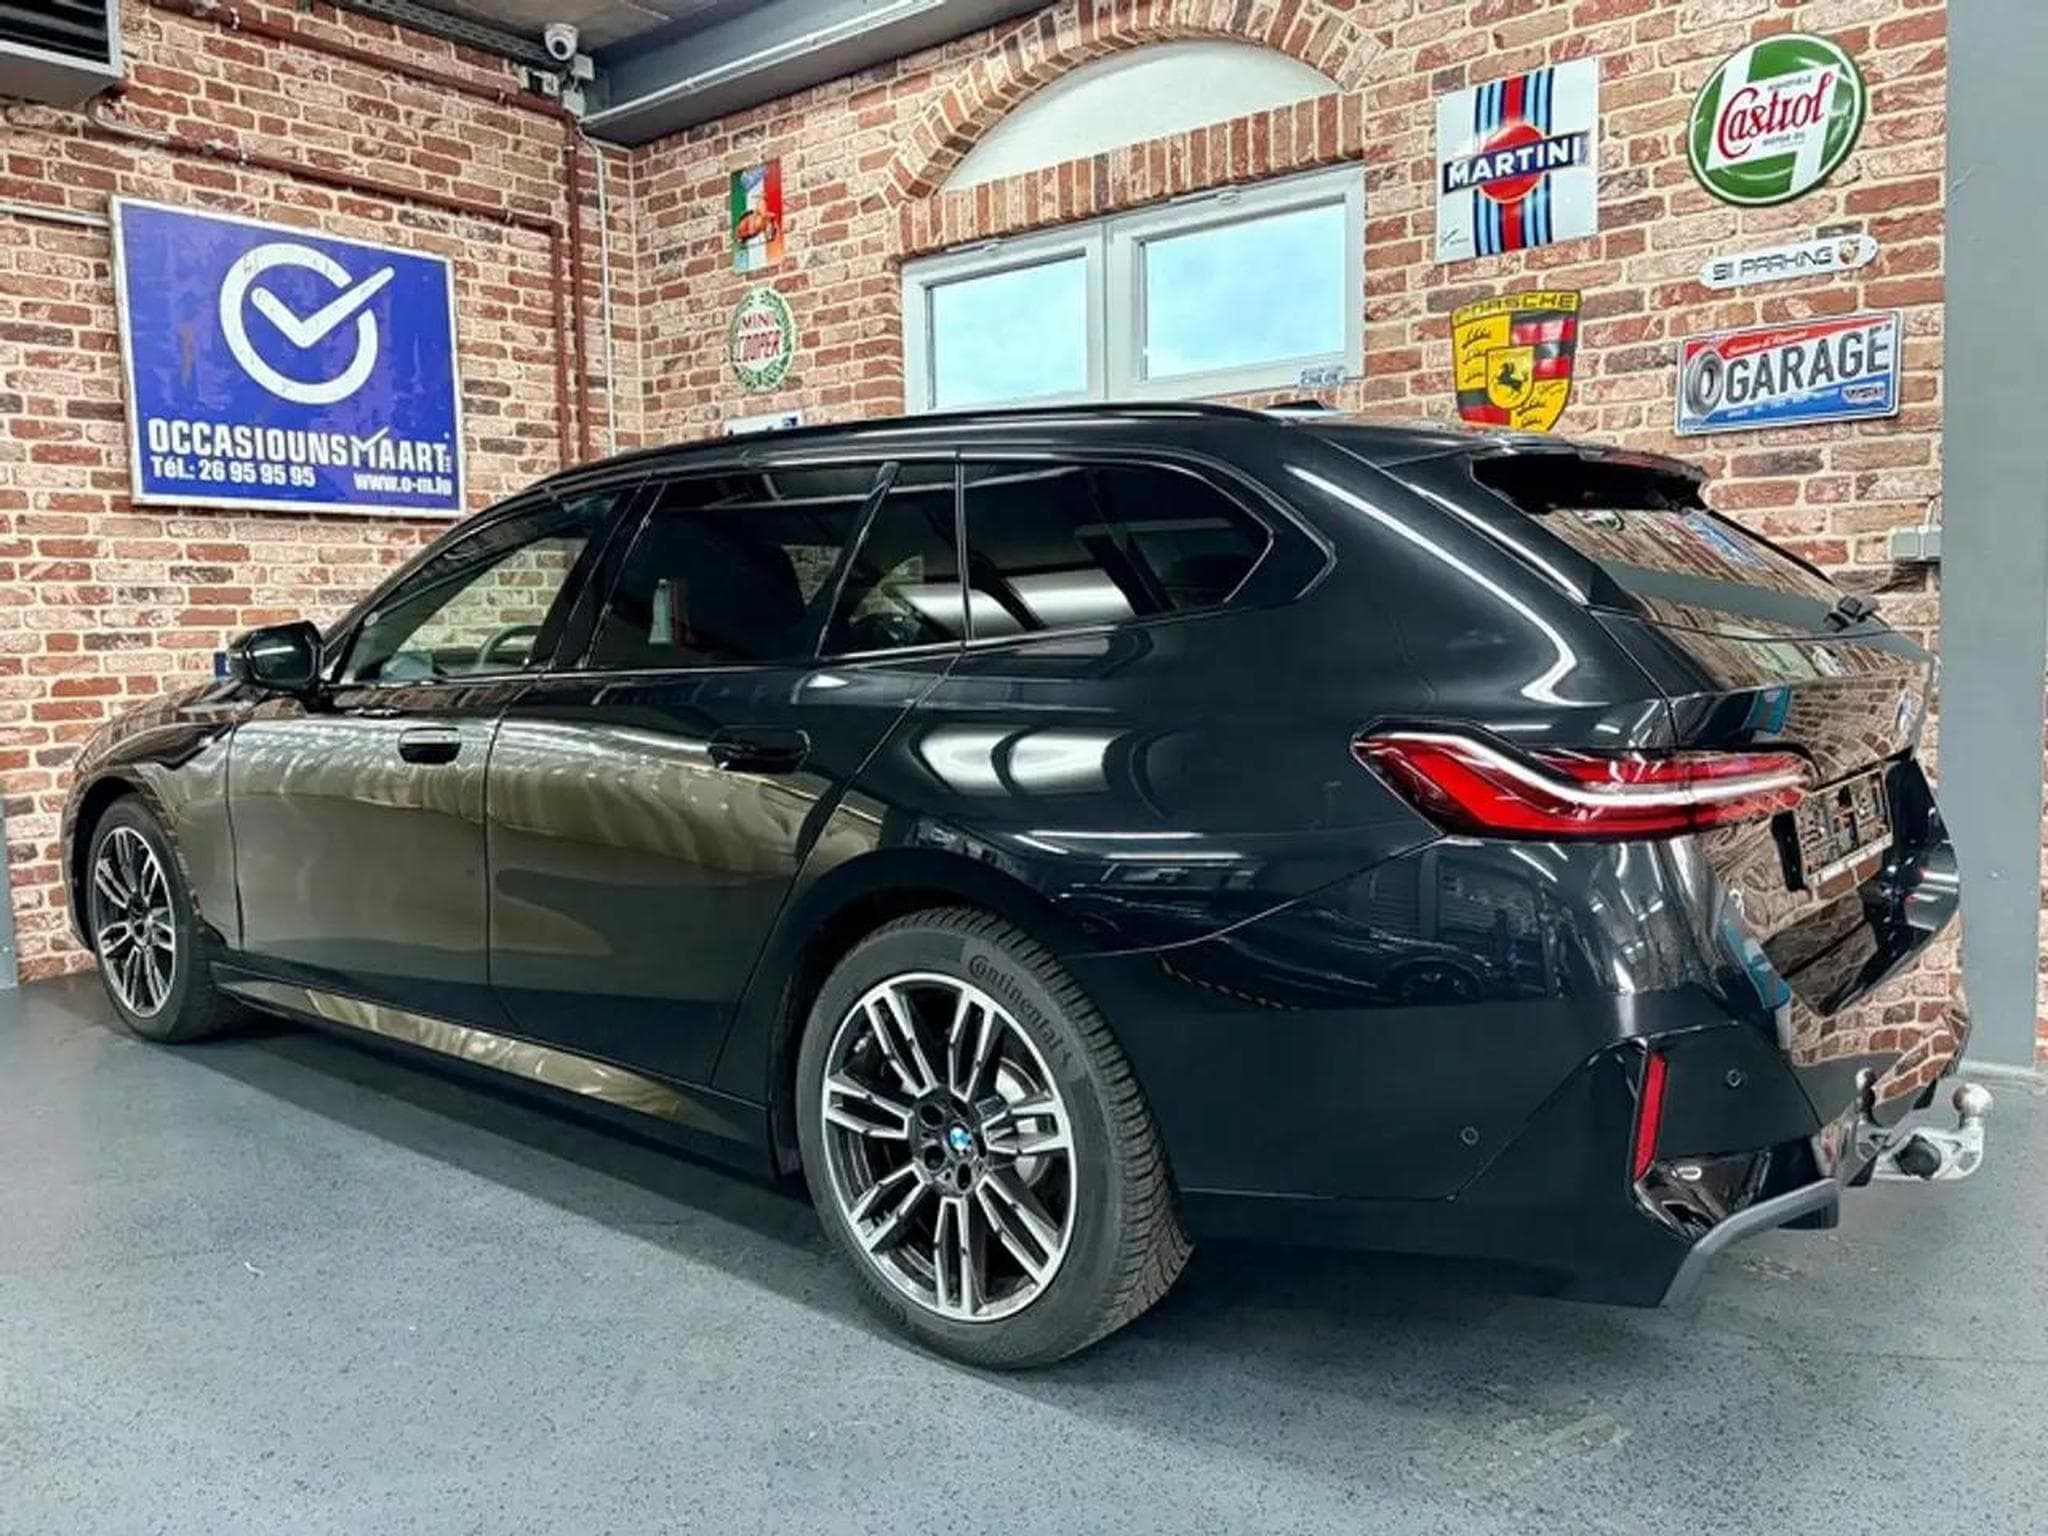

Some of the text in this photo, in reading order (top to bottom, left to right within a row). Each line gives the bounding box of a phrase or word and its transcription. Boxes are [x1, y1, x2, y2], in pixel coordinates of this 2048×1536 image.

[1718, 71, 1834, 159] Castrol
[1448, 136, 1580, 188] MARTINI
[1741, 246, 1832, 277] PARKING
[735, 329, 781, 362] COOPER
[1726, 324, 1892, 404] GARAGE
[199, 458, 226, 481] 26
[229, 461, 257, 484] 95
[260, 463, 287, 486] 95
[289, 465, 316, 488] 95
[968, 954, 1064, 1051] Continental
